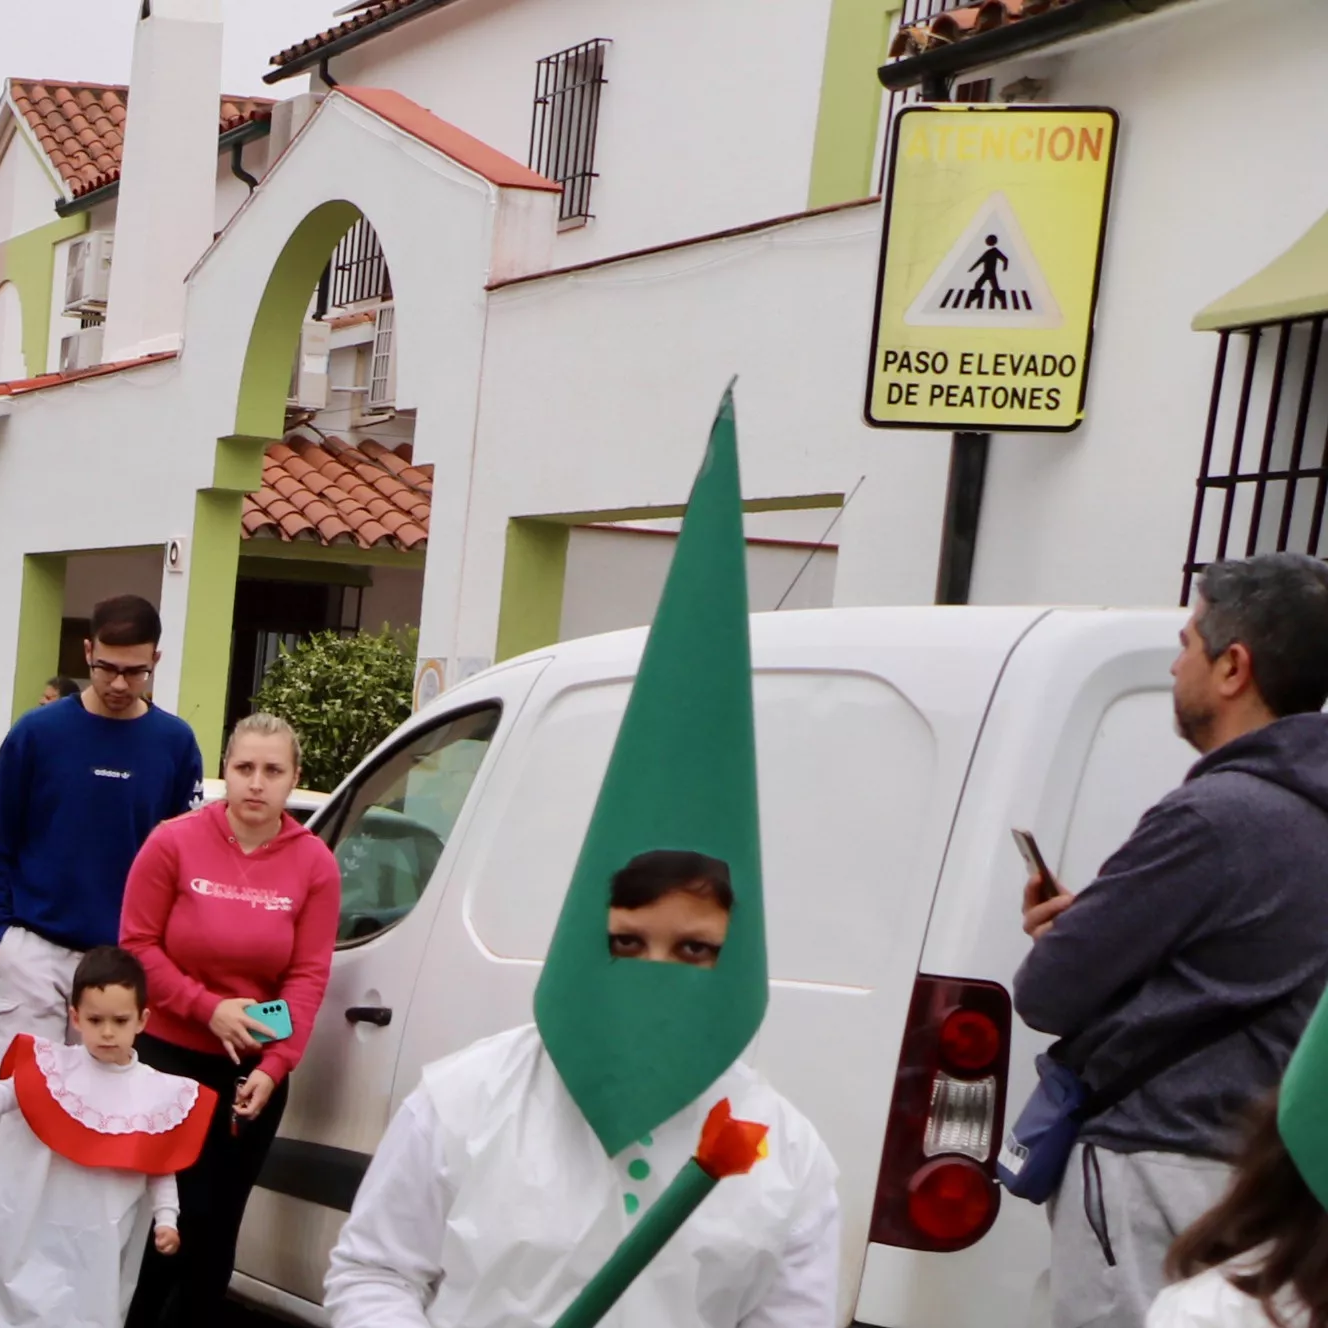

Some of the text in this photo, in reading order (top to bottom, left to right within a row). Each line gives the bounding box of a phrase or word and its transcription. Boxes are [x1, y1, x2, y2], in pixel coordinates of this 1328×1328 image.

[906, 124, 1104, 162] ATENCION
[883, 350, 1076, 378] PASO ELEVADO
[887, 383, 1062, 411] DE PEATONES
